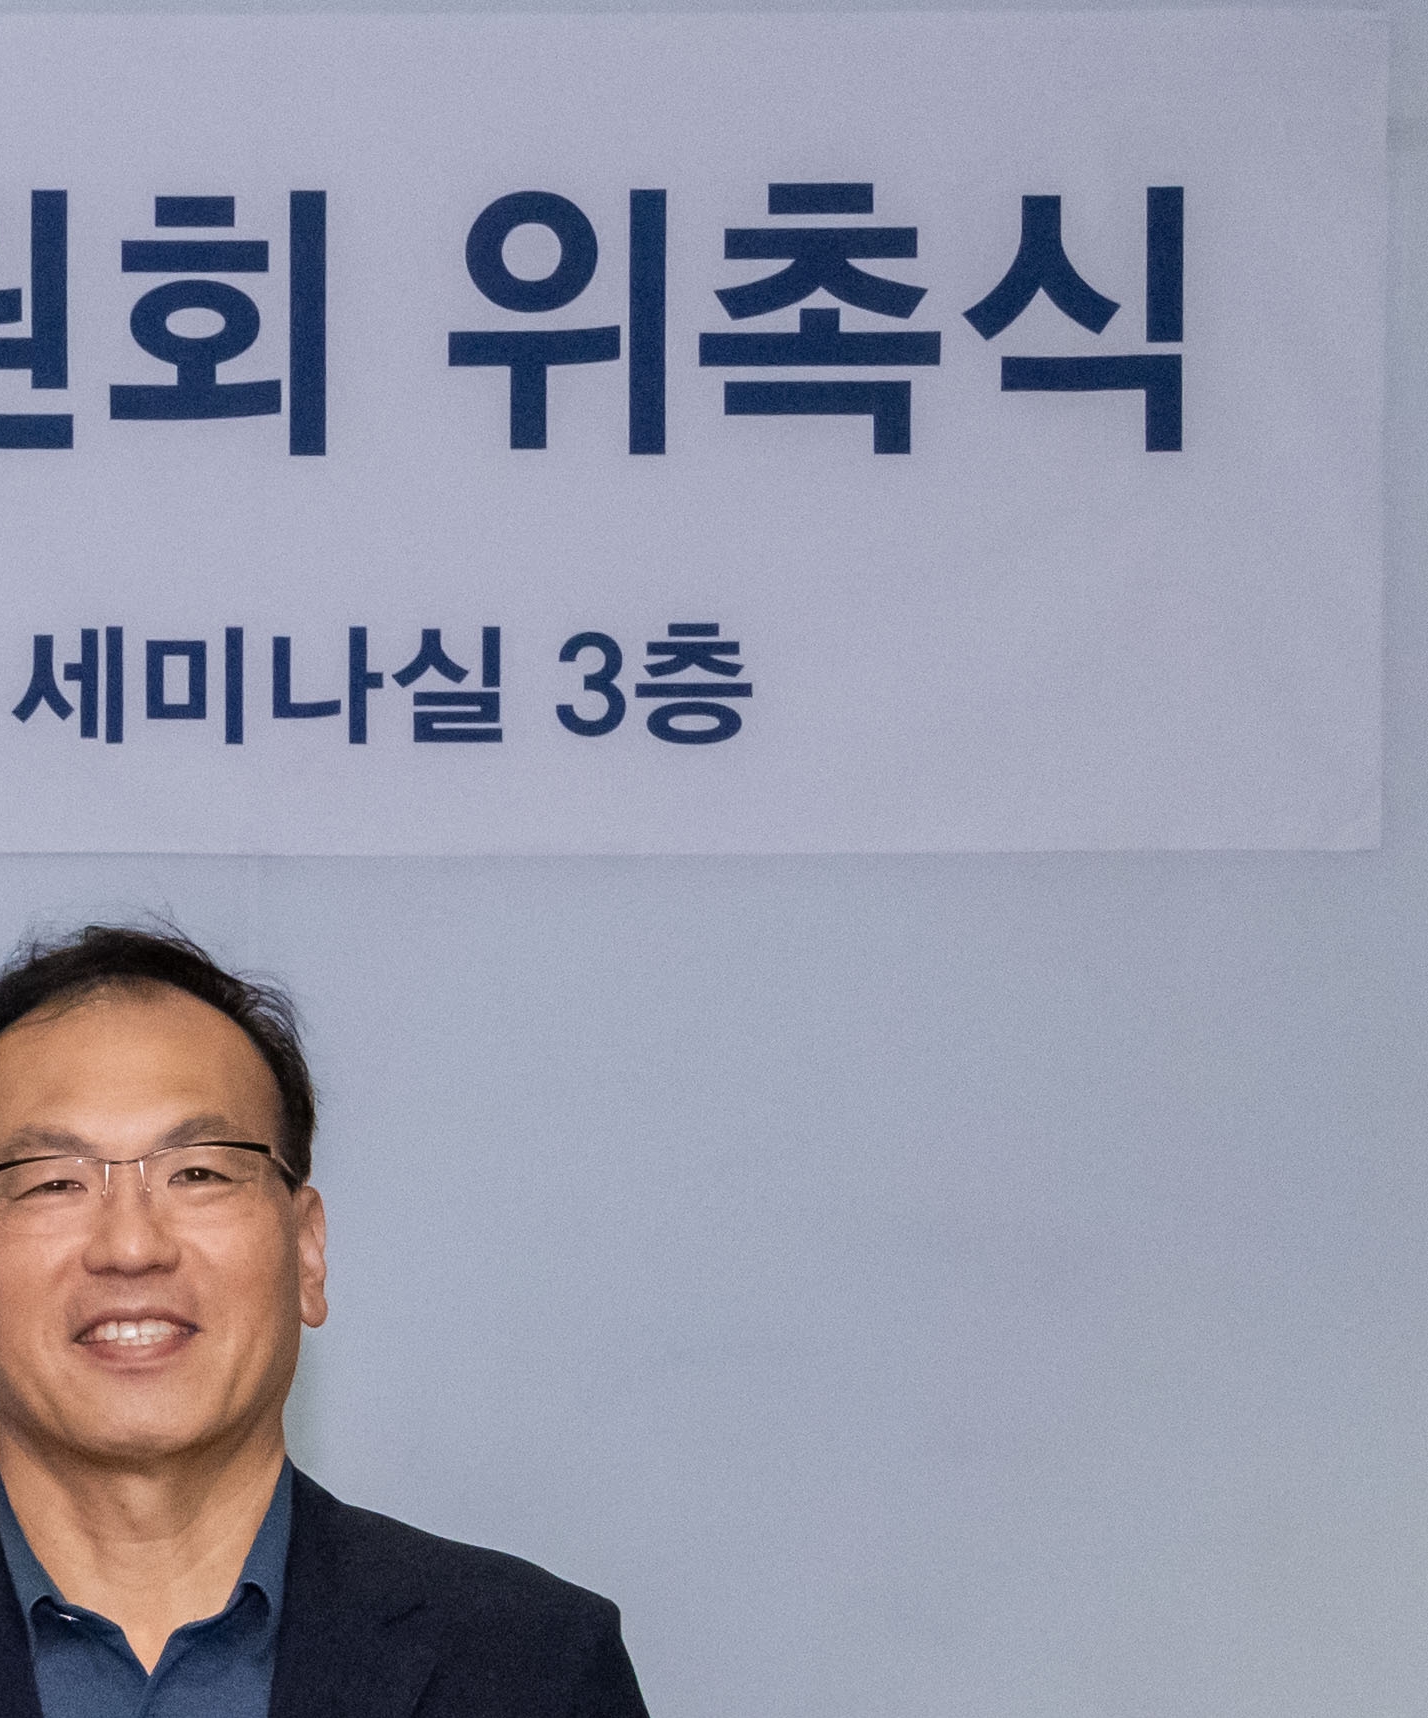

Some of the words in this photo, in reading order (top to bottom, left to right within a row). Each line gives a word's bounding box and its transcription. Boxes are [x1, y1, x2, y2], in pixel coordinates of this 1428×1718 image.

[449, 183, 1184, 455] 위촉식
[13, 627, 502, 744] 세미나실
[556, 623, 752, 745] 3층
